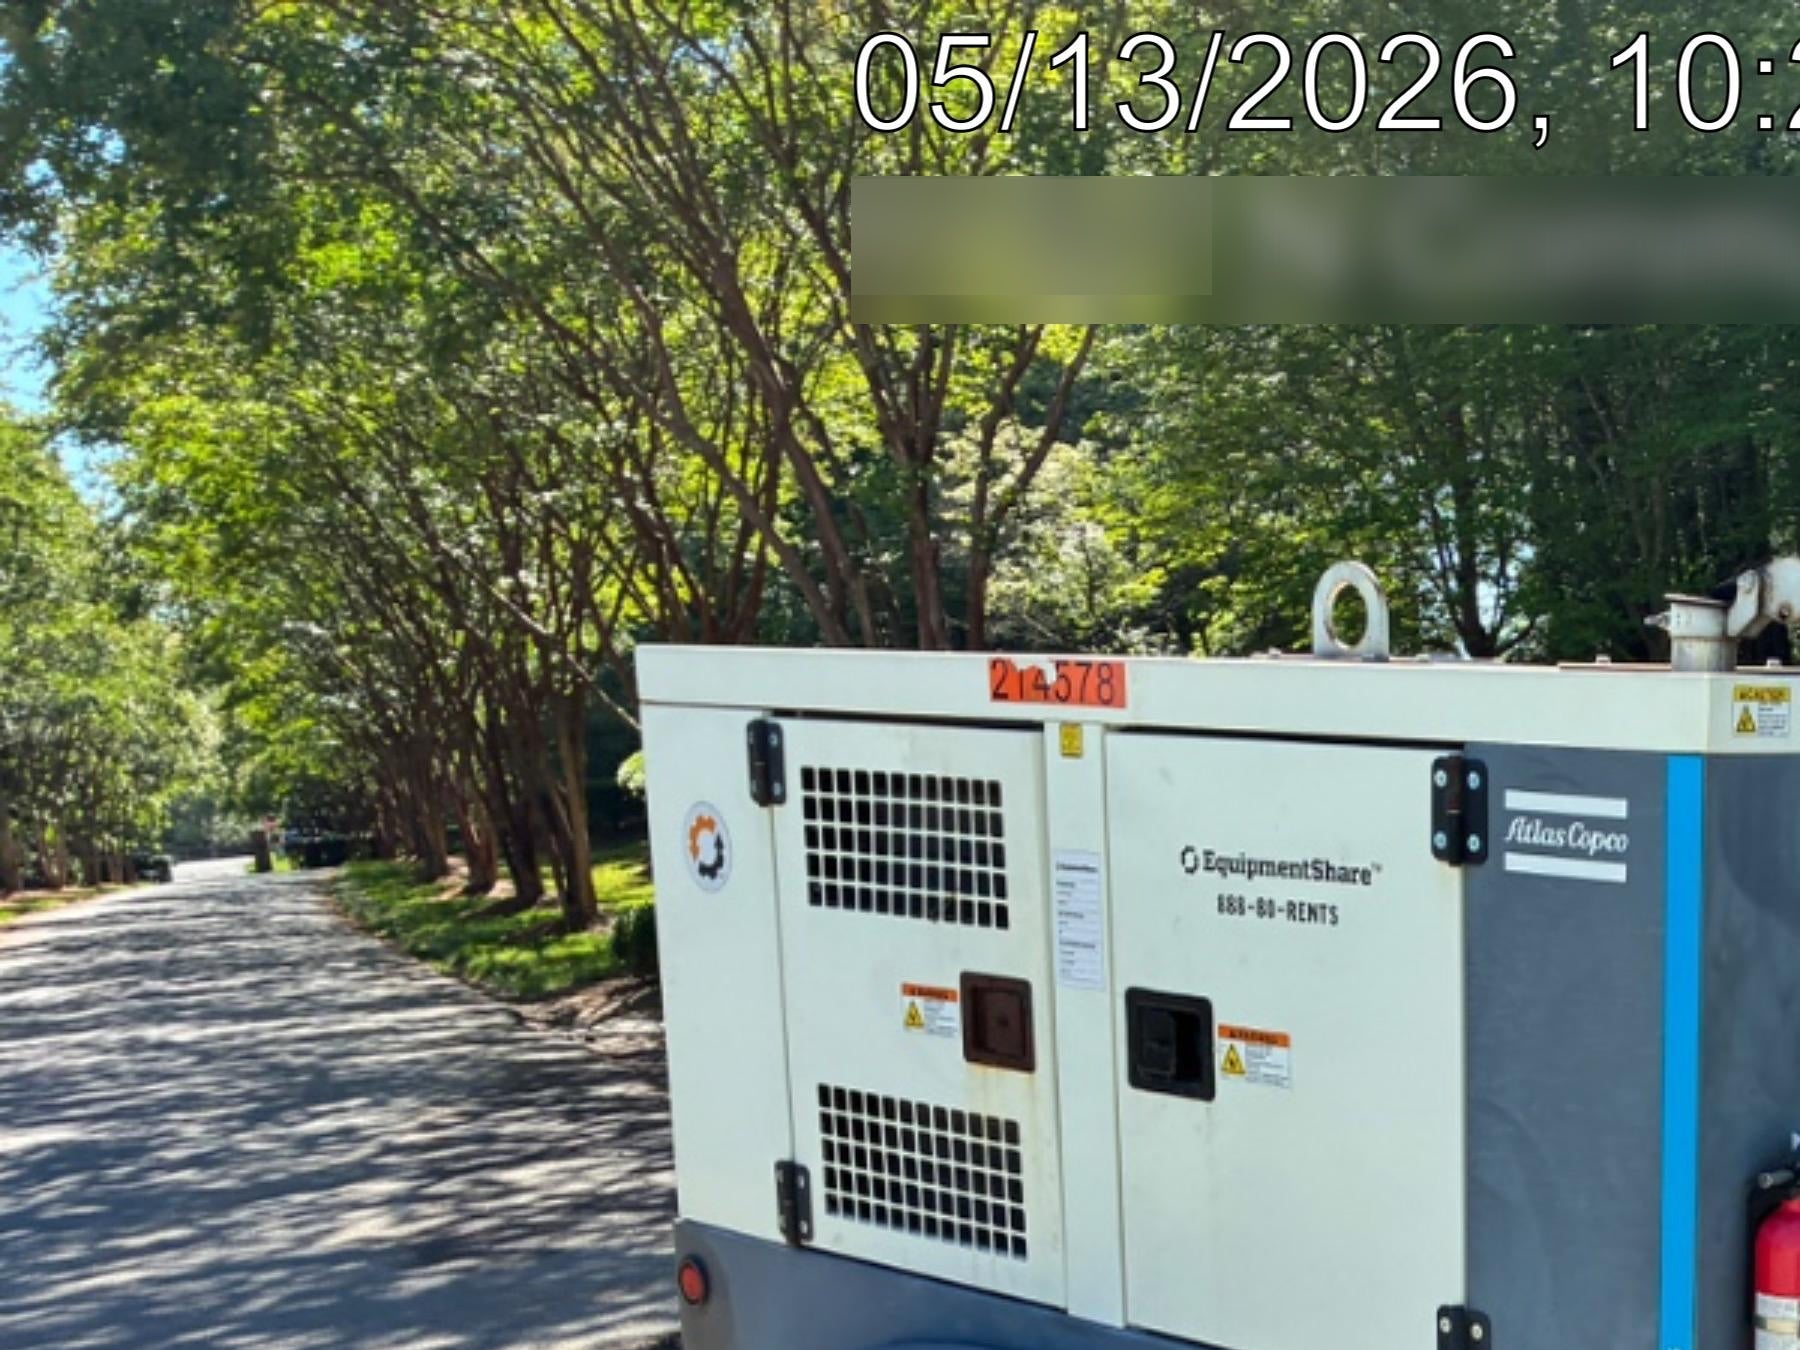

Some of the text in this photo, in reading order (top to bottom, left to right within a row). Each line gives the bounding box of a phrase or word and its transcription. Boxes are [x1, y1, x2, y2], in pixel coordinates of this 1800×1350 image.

[991, 658, 1113, 705] 214578
[1505, 816, 1629, 856] Atlas Copco
[1217, 894, 1339, 926] 888-80-RENTS
